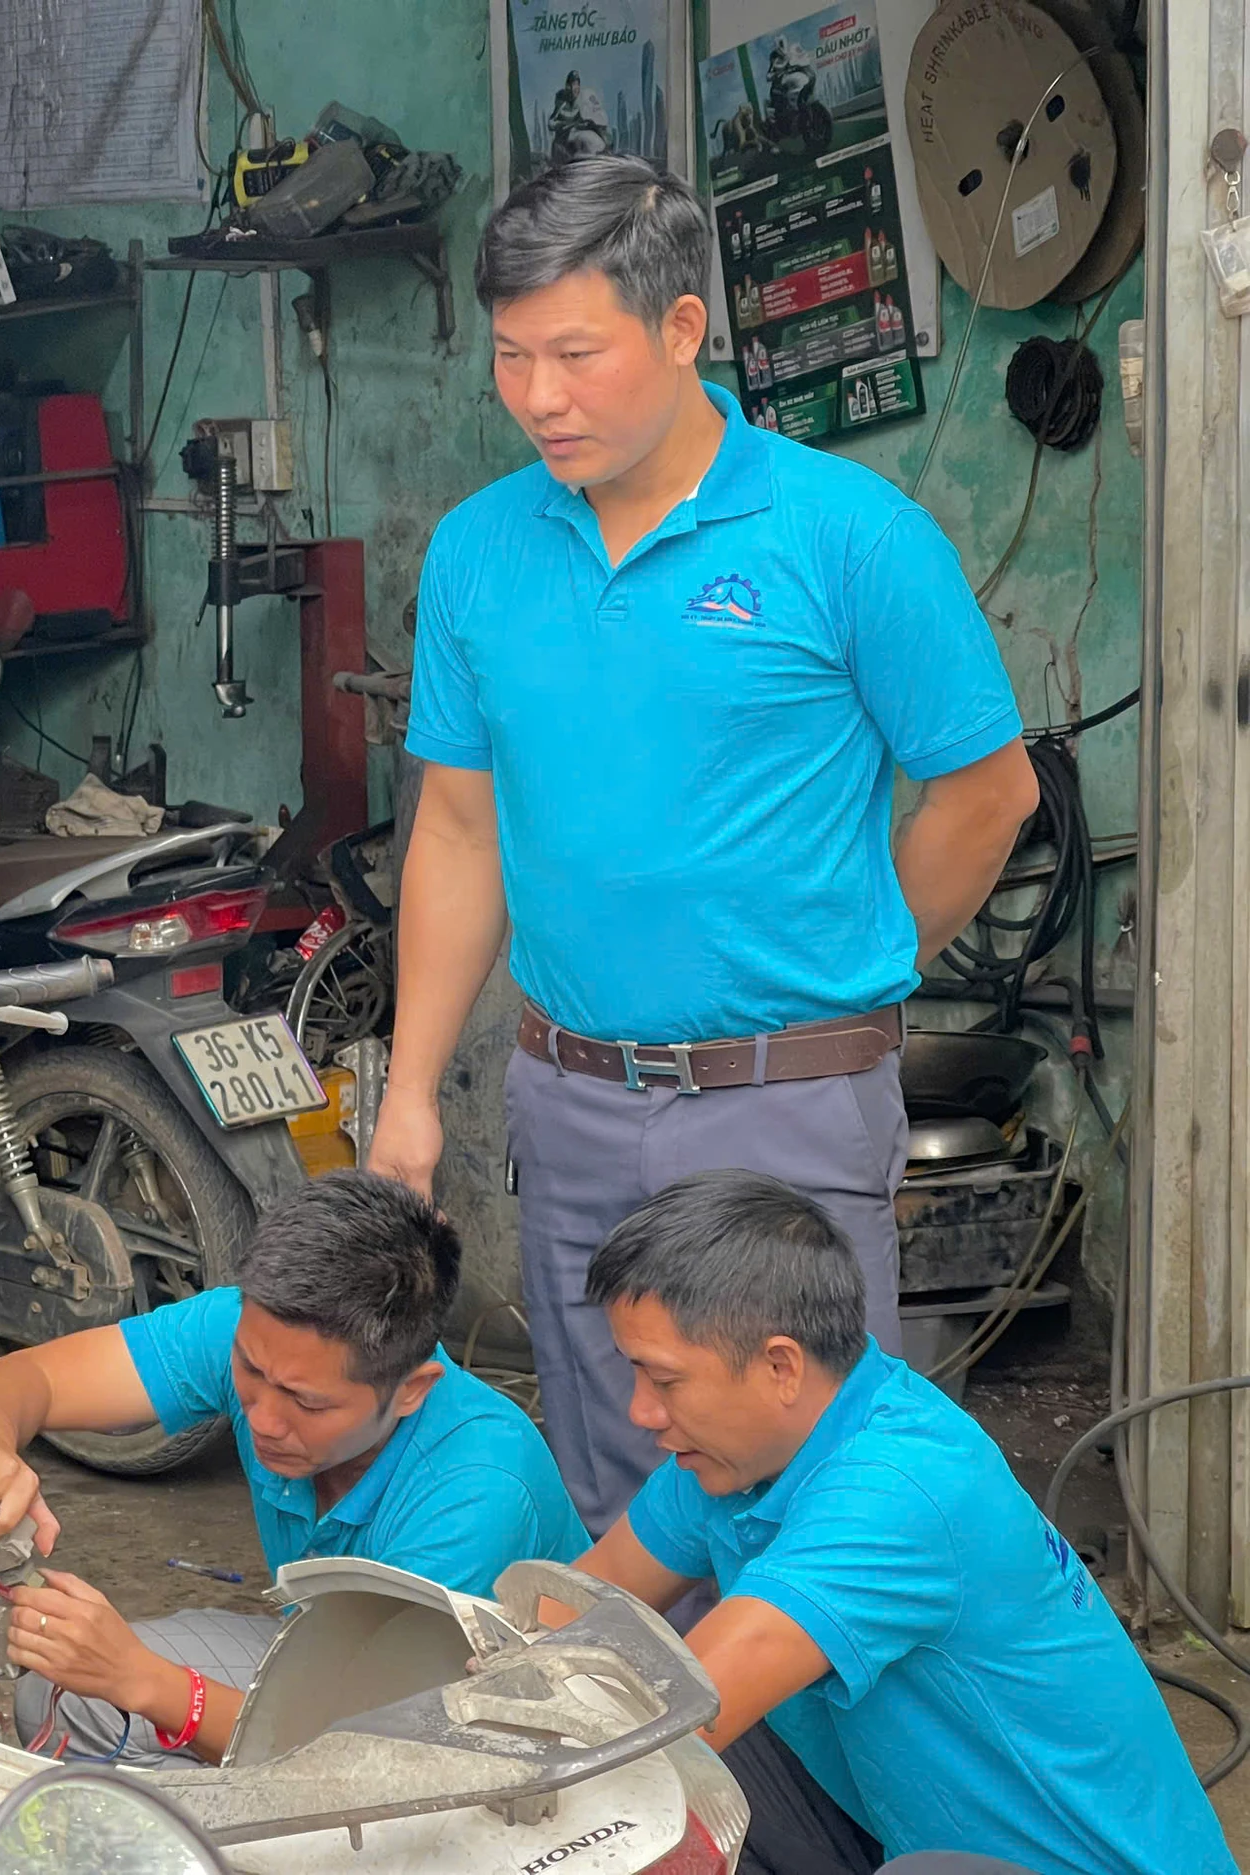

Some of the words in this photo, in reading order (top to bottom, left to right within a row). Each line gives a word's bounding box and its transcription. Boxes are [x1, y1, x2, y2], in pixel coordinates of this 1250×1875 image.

[534, 9, 568, 32] TĂNG
[571, 2, 597, 30] TỐC
[539, 32, 582, 52] NHANH
[583, 30, 612, 48] NHƯ
[924, 3, 992, 84] SHRINKABLE
[920, 92, 934, 143] HEAT
[194, 1021, 284, 1072] 36-K5
[210, 1063, 316, 1119] 280.41
[521, 1820, 638, 1875] HONDA
